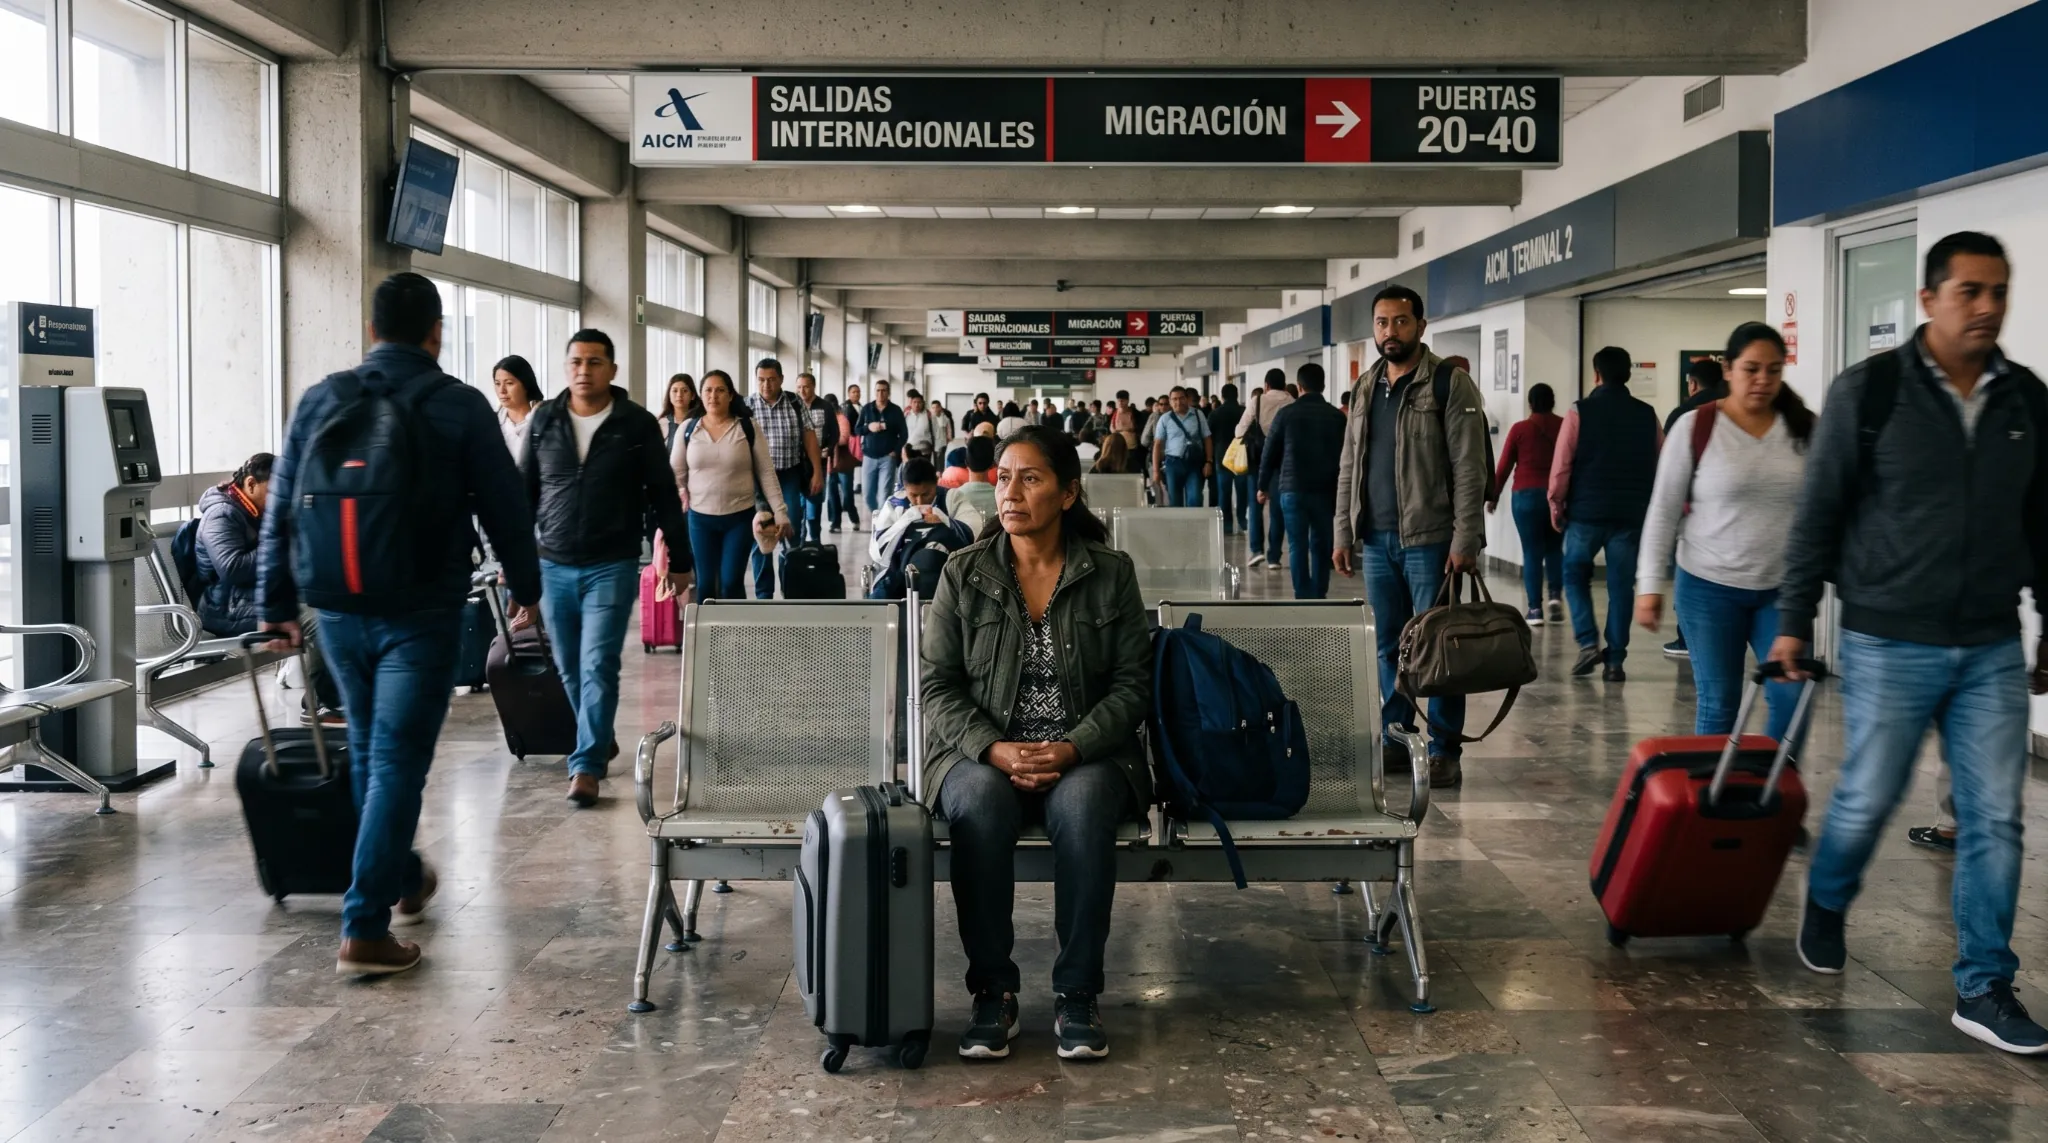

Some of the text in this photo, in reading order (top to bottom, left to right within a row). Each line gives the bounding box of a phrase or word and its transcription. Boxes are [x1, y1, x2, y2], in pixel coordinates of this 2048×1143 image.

[771, 85, 892, 113] SALIDAS
[1418, 85, 1537, 111] PUERTAS
[1105, 98, 1286, 136] MIGRACIÓN
[641, 134, 693, 149] AICM
[771, 121, 1035, 148] INTERNACIONALES
[1417, 115, 1537, 154] 20-40
[1485, 224, 1573, 285] AICM, TERMINAL 2
[968, 313, 1006, 323] SALIDAS
[1067, 317, 1122, 329] MIGRACIÓN
[1160, 313, 1196, 322] PUERTAS
[968, 323, 1050, 334] INTERNACIONALES
[1160, 322, 1197, 334] 20-40
